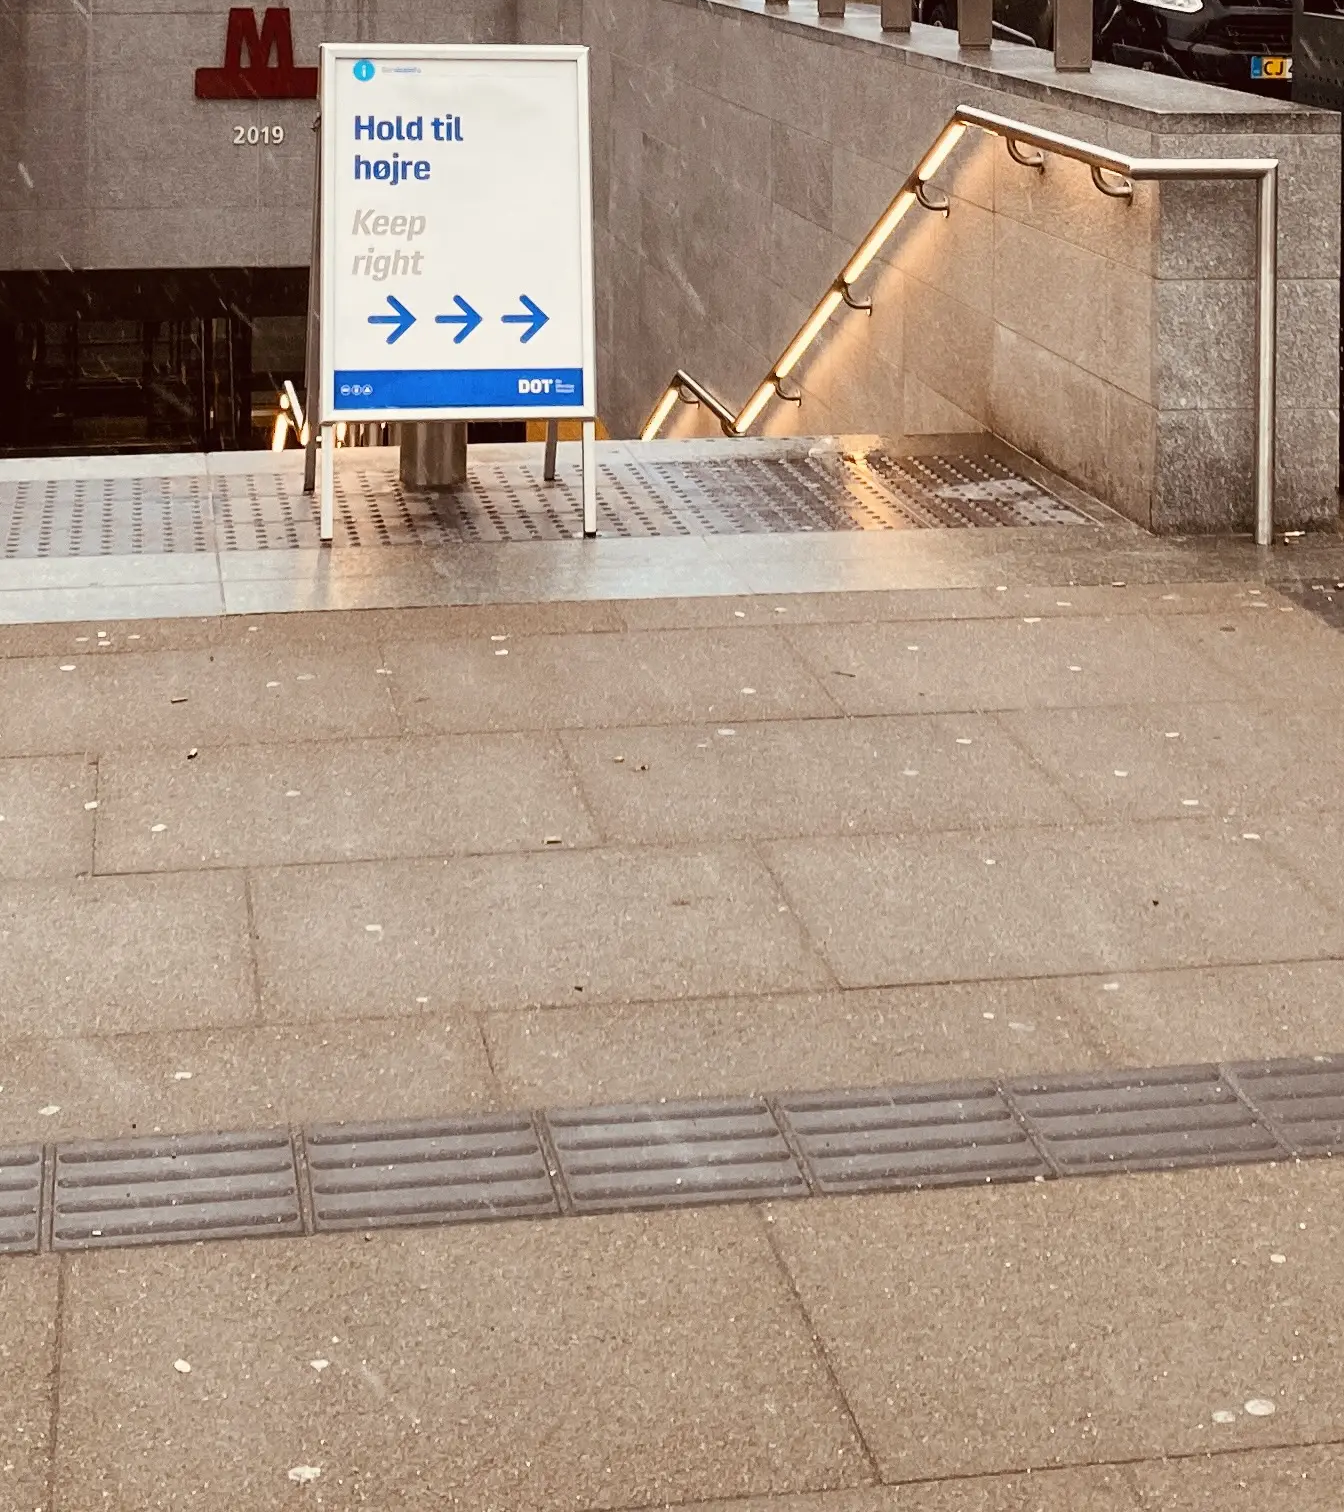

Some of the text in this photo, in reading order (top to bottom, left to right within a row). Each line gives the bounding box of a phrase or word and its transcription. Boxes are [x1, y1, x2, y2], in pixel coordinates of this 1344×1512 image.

[232, 125, 285, 145] 2019
[354, 113, 464, 142] Hold til
[354, 153, 431, 186] højre
[351, 209, 427, 241] Keep
[351, 249, 425, 282] right
[518, 378, 553, 394] DOT
